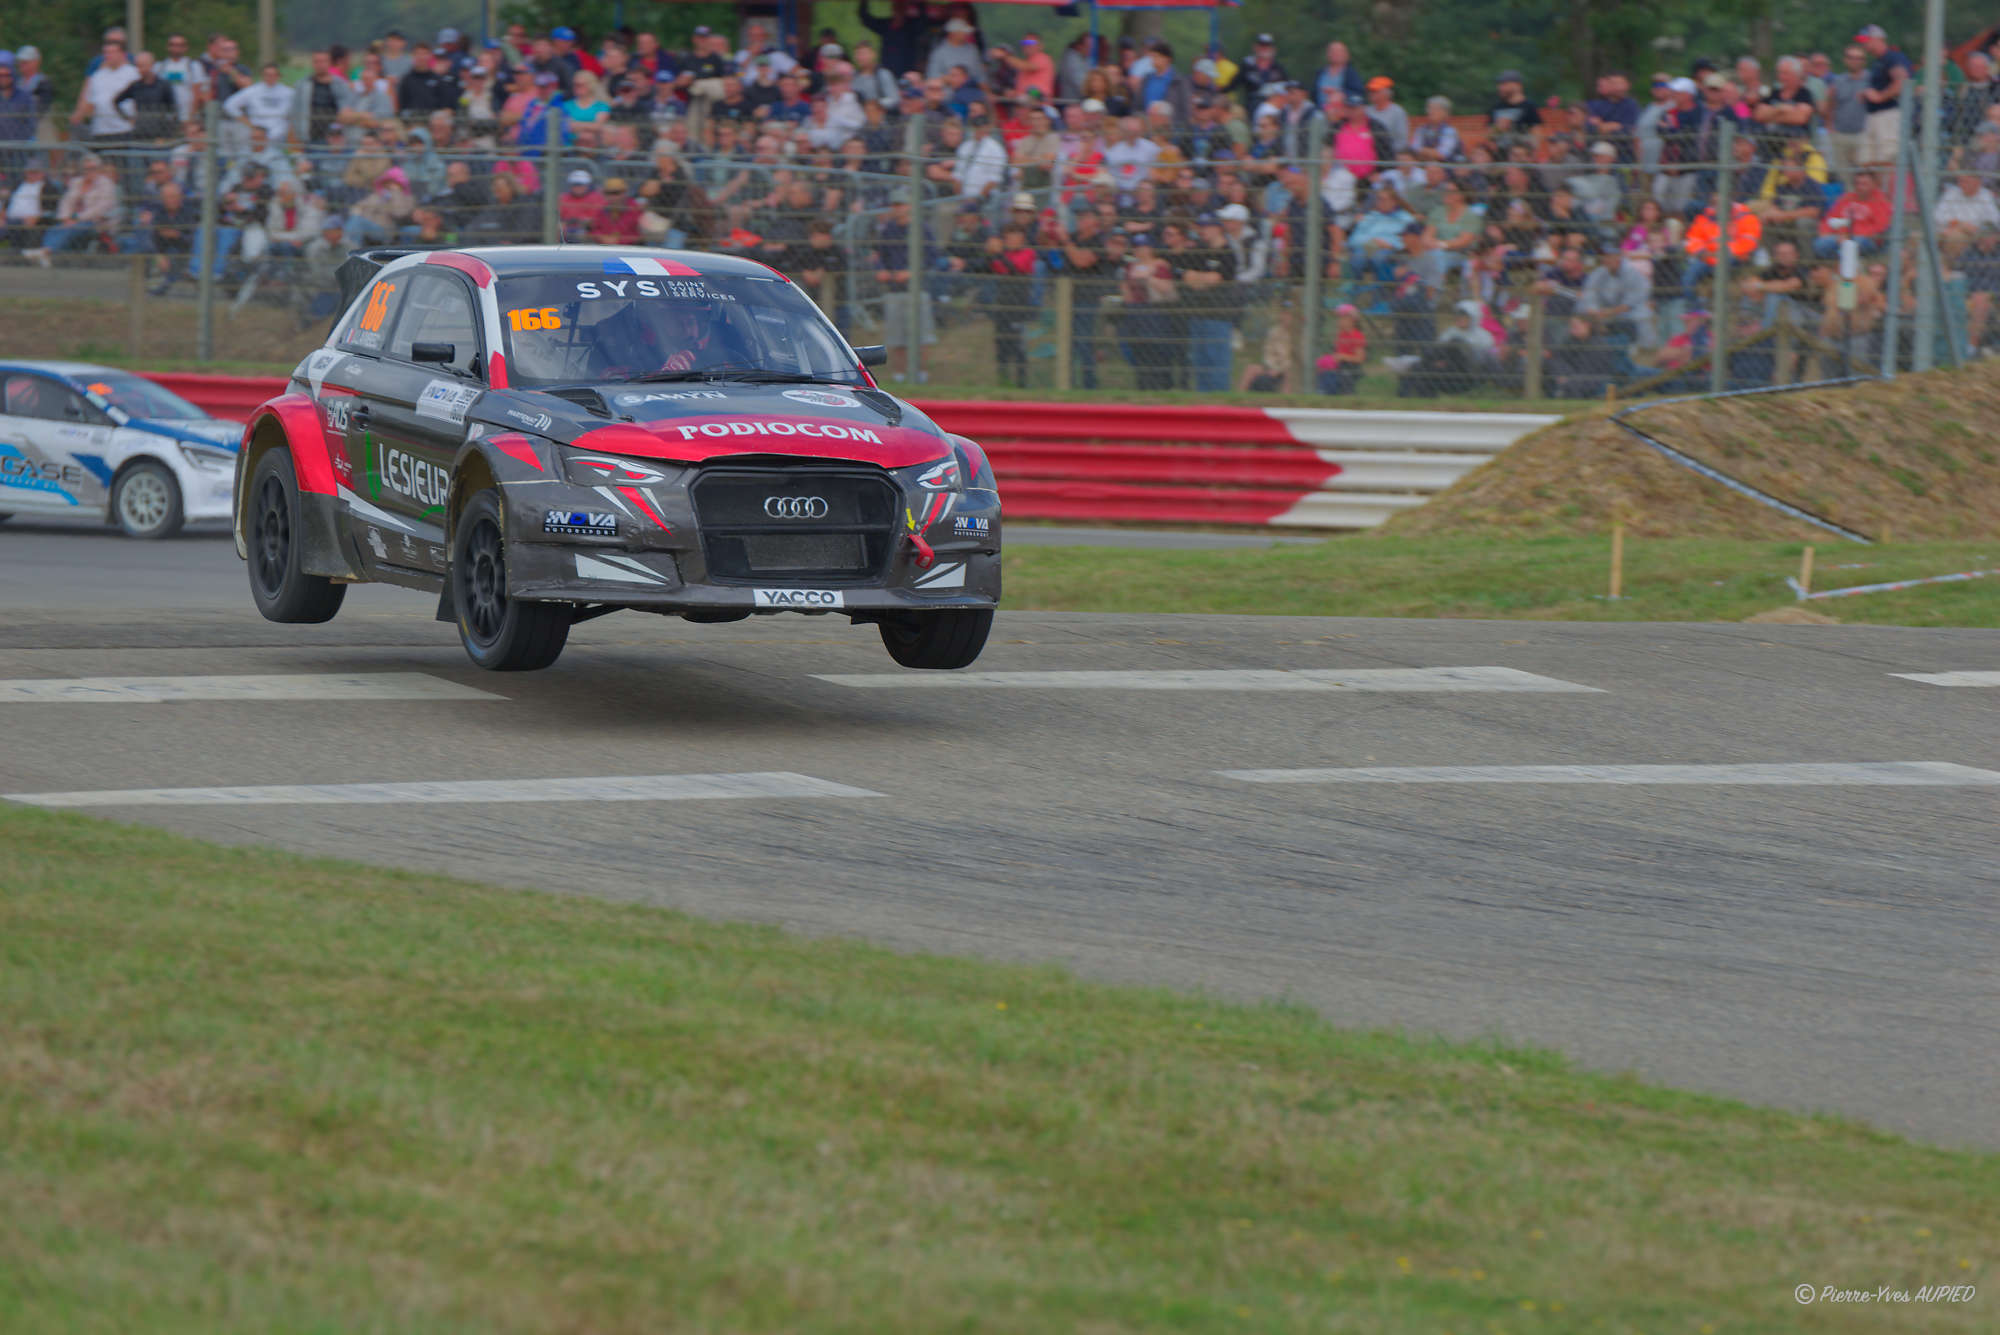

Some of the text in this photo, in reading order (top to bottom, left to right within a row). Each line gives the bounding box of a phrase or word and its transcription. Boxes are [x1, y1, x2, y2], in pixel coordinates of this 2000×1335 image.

[576, 280, 661, 299] SYS
[667, 280, 705, 288] SAINT
[672, 291, 736, 301] SERVICES
[361, 281, 395, 332] 166
[507, 308, 561, 332] 166
[622, 390, 728, 402] SAMYN
[677, 422, 883, 445] PODIOCOM
[379, 442, 450, 506] LESIEUR
[544, 527, 616, 536] MOTORSPORT
[762, 590, 836, 605] YACCO
